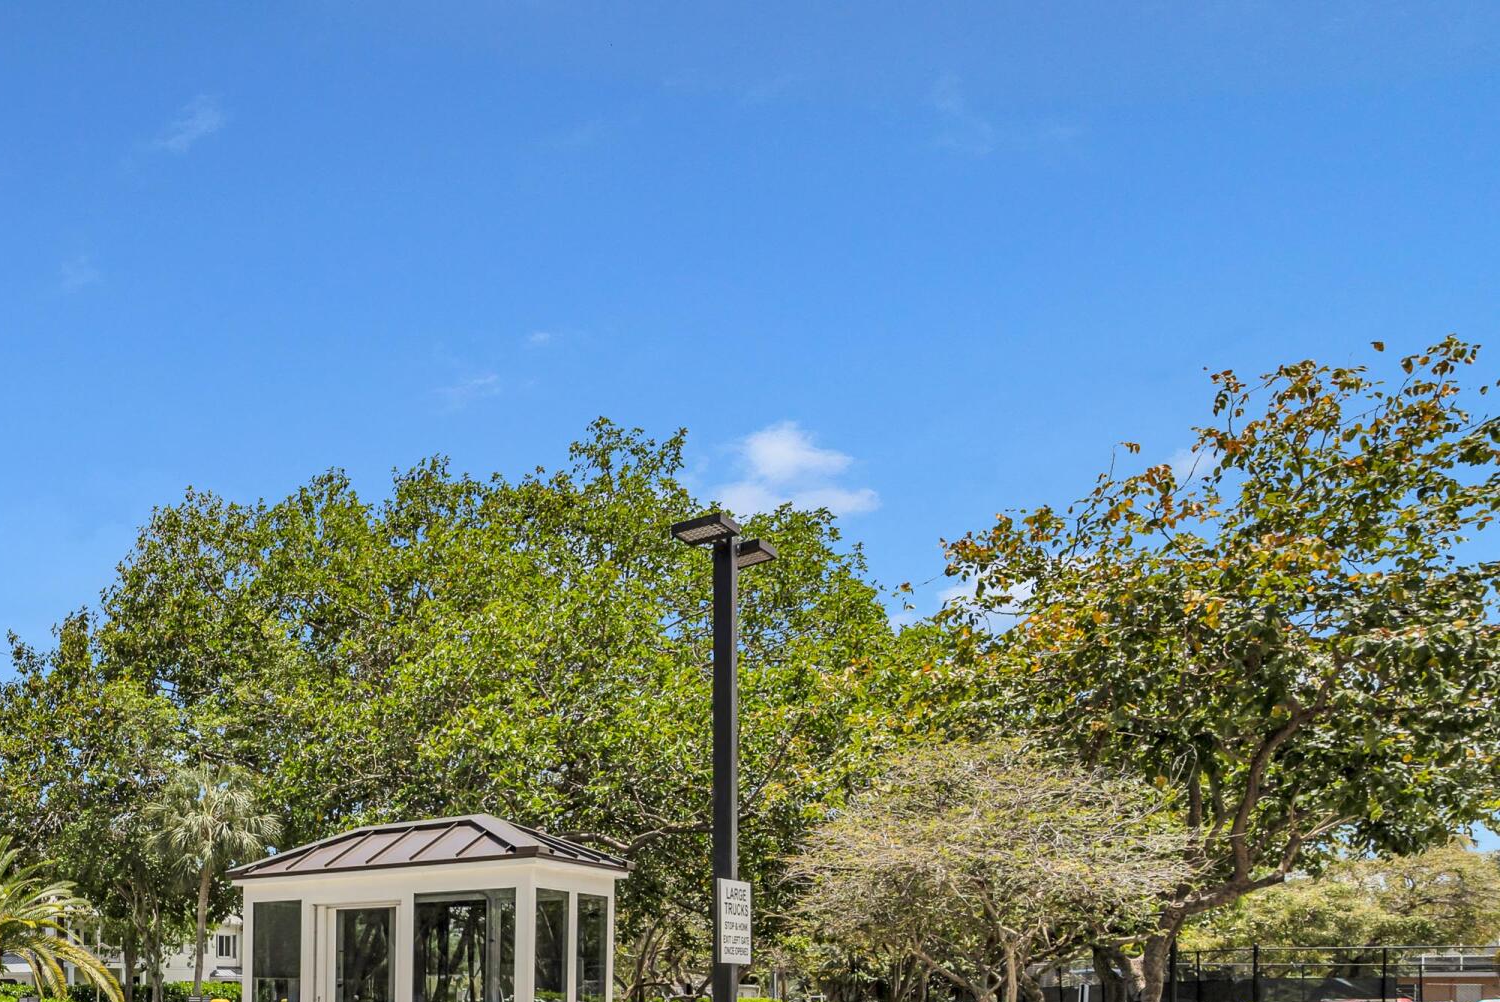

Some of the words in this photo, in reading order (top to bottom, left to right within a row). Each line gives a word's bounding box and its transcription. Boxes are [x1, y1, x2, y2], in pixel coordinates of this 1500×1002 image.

[726, 888, 747, 902] LARGE
[724, 902, 749, 917] TRUCKS
[725, 921, 734, 930] STOP
[732, 936, 740, 945] LEFT
